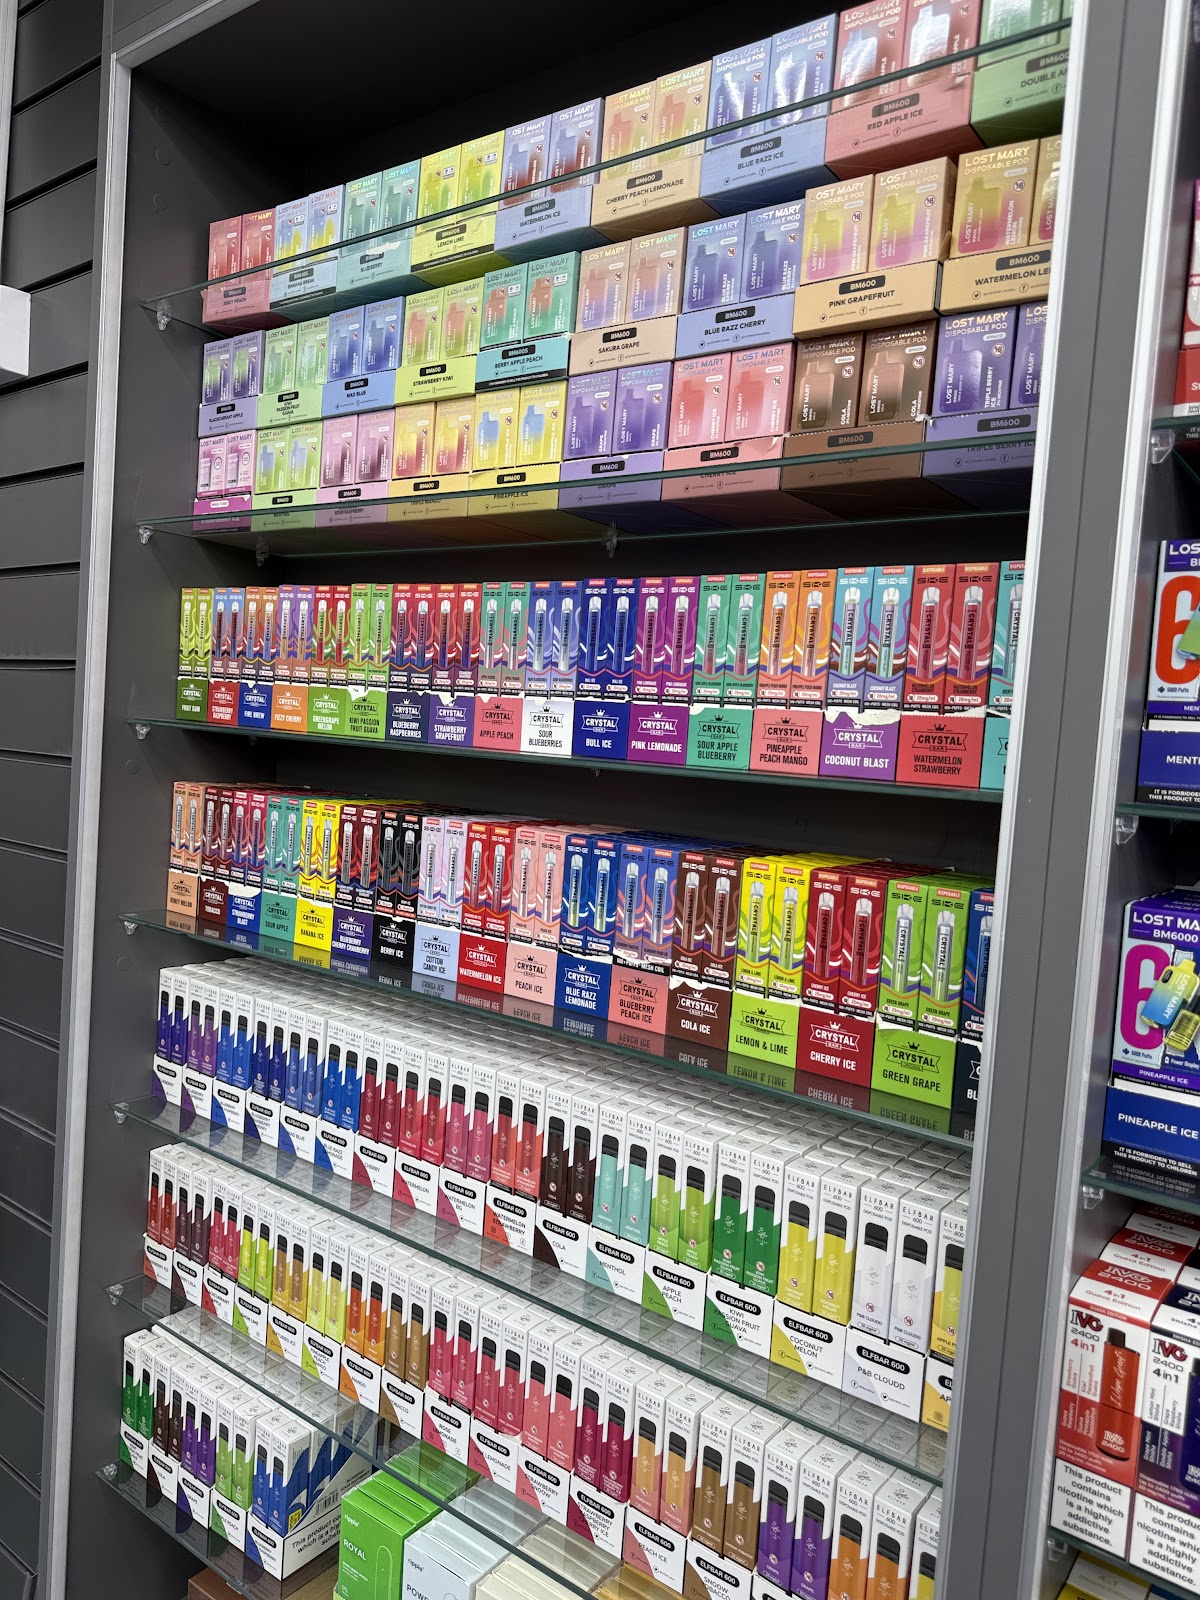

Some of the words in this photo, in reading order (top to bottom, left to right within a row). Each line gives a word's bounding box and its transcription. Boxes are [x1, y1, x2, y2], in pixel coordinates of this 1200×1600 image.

[1021, 72, 1056, 88] DOUBLE
[868, 122, 882, 130] RED
[884, 112, 908, 127] APPLE
[910, 109, 923, 118] ICE
[738, 159, 753, 170] BLUE
[755, 155, 772, 165] RAZZ
[774, 151, 784, 159] ICE
[965, 154, 995, 167] LOST
[997, 147, 1030, 160] MARY
[965, 161, 1010, 175] DISPOSABLE
[606, 194, 628, 204] CHERRY
[629, 188, 648, 199] PEACH
[650, 179, 683, 193] LEMONADE
[520, 213, 552, 227] WATERMELON
[850, 280, 876, 290] BM600
[976, 271, 1031, 286] WATERMELON
[829, 298, 846, 308] PINK
[848, 290, 895, 305] GRAPEFRUIT
[705, 326, 720, 335] BLUE
[722, 323, 738, 332] RAZZ
[740, 319, 766, 330] CHERRY
[945, 318, 974, 330] LOST
[977, 312, 1008, 325] MARY
[945, 327, 990, 337] DISPOSABLE
[991, 322, 1008, 331] POD
[599, 344, 619, 353] SAKURA
[621, 341, 639, 350] GRAPE
[495, 360, 509, 369] BERRY
[413, 378, 440, 386] STRAWBERRY
[990, 418, 1020, 428] BM600
[710, 449, 732, 458] BM600
[350, 724, 361, 733] FRUIT
[363, 726, 378, 734] GUAVA
[360, 718, 379, 726] PASSION
[393, 721, 419, 730] BLUEBERRY
[390, 728, 421, 738] RASPBERRIES
[480, 730, 496, 739] APPLE
[498, 731, 513, 740] PEACH
[539, 730, 552, 738] SOUR
[529, 738, 562, 748] BLUEBERRIES
[586, 739, 600, 748] BULL
[602, 740, 611, 749] ICE
[632, 741, 646, 750] PINK
[648, 742, 682, 752] LEMONADE
[697, 741, 715, 749] SOUR
[717, 742, 738, 752] APPLE
[918, 735, 962, 746] CRYSTAL
[698, 751, 736, 761] BLUEBERRY
[766, 743, 802, 755] PINEAPPLE
[760, 754, 782, 764] PEACH
[784, 755, 808, 766] MANGO
[825, 755, 861, 767] COCONUT
[863, 757, 889, 768] BLAST
[914, 755, 962, 765] WATERMELON
[913, 764, 961, 775] STRAWBERRY
[1133, 912, 1173, 928] LOST
[1153, 929, 1198, 943] BM6000
[380, 946, 393, 956] BERRY
[395, 949, 404, 958] ICE
[423, 963, 437, 973] CANDY
[426, 956, 443, 966] COTTON
[460, 968, 490, 983] WATERMELON
[492, 975, 501, 984] ICE
[566, 987, 580, 996] BLUE
[582, 991, 596, 1000] RAZZ
[565, 995, 596, 1010] LEMONADE
[620, 999, 654, 1014] BLUEBERRY
[621, 1009, 639, 1021] PEACH
[642, 1014, 652, 1023] ICE
[681, 1019, 697, 1032] COLA
[699, 1024, 710, 1034] ICE
[736, 1034, 760, 1047] LEMON
[763, 1042, 768, 1050] &
[770, 1043, 788, 1055] LIME
[810, 1051, 840, 1066] CHERRY
[843, 1059, 856, 1071] ICE
[892, 1049, 935, 1066] CRYSTAL
[883, 1069, 909, 1084] GREEN
[913, 1077, 940, 1093] GRAPE
[1139, 1069, 1175, 1082] PINEAPPLE
[1118, 1113, 1177, 1134] PINEAPPLE
[1180, 1127, 1198, 1139] ICE
[1128, 1153, 1155, 1164] PRODUCT
[1166, 1163, 1197, 1176] CHILDREN
[1133, 1149, 1168, 1162] FORBIDDEN
[1178, 1160, 1192, 1169] SELL
[864, 1195, 894, 1210] ELFBAR
[552, 1240, 566, 1251] COLA
[656, 1268, 679, 1283] ELFBAR
[680, 1277, 691, 1287] 600
[661, 1291, 682, 1303] PEACH
[662, 1285, 682, 1297] APPLE
[1085, 1289, 1111, 1302] Guava
[1112, 1296, 1141, 1311] Edition
[1071, 1309, 1104, 1331] IVG
[1071, 1328, 1100, 1342] 2400
[789, 1335, 823, 1353] COCONUT
[794, 1344, 818, 1358] MELON
[1071, 1338, 1079, 1347] 4
[1080, 1342, 1089, 1351] in
[1089, 1343, 1095, 1352] 1
[862, 1350, 890, 1368] ELFBAR
[890, 1360, 905, 1371] 600
[857, 1366, 872, 1377] P&B
[874, 1373, 905, 1390] CLOUDD
[1064, 1464, 1083, 1479] This
[1084, 1471, 1122, 1496] product
[1071, 1480, 1111, 1501] contains
[1058, 1485, 1094, 1505] nicotine
[1095, 1498, 1124, 1518] which
[1066, 1499, 1074, 1508] is
[1085, 1505, 1113, 1525] highly
[1068, 1510, 1109, 1534] addictive
[638, 1525, 659, 1540] ELFBAR
[660, 1538, 671, 1549] 600
[1063, 1519, 1112, 1546] substance.
[343, 1538, 367, 1561] ROYAL
[658, 1553, 667, 1563] ICE
